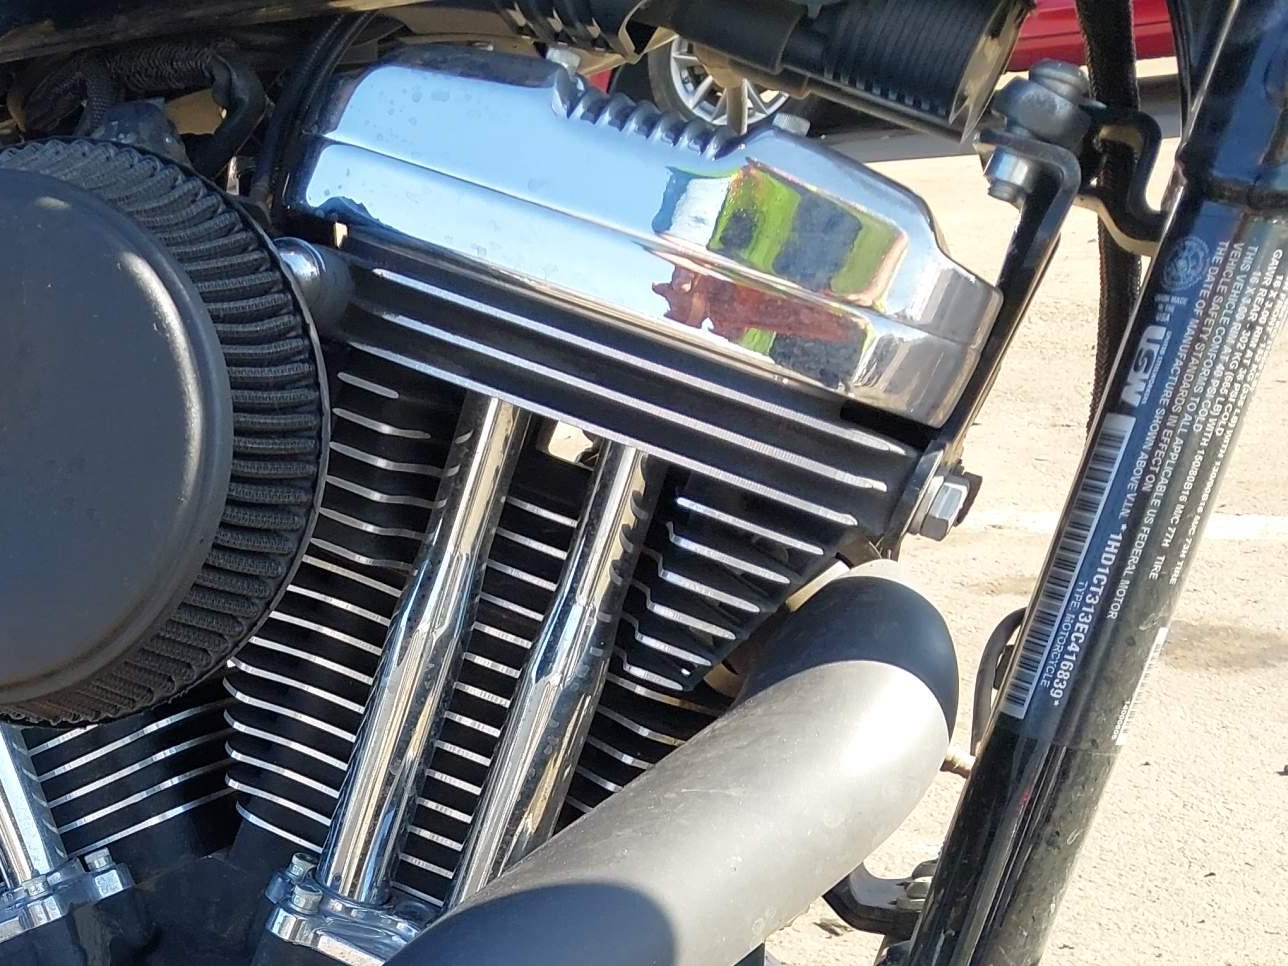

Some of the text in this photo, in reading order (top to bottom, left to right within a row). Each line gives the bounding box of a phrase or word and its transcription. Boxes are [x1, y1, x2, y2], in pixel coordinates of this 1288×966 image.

[1210, 239, 1230, 264] THE
[1260, 249, 1283, 286] GAWR
[1198, 266, 1220, 297] DATE
[1191, 299, 1208, 315] OF
[1247, 288, 1268, 321] REAR
[1225, 322, 1242, 344] RIM
[1235, 330, 1250, 348] 302
[1248, 326, 1264, 347] RIM
[1117, 321, 1167, 405] USW
[1140, 241, 1245, 491] VEHICLE SAFETY STANDARDS IN EFFECT ON
[1157, 318, 1199, 405] MANUFACTURE
[1219, 347, 1233, 361] AT
[1228, 352, 1242, 369] KG
[1241, 350, 1254, 364] AT
[1204, 379, 1220, 397] PSI
[1227, 384, 1240, 400] PSI
[1191, 399, 1212, 431] COLD
[1209, 397, 1224, 415] LB)
[1105, 244, 1259, 619] THIS VEHICLE CONFORMS TO ALL APPLICABLE US FEDERAL MOTOR
[1141, 407, 1166, 450] SHOWN
[1198, 418, 1217, 445] WITH
[1214, 406, 1232, 435] COLD
[1216, 430, 1233, 456] WITH
[1125, 452, 1150, 491] ABOVE
[1178, 449, 1205, 501] 150/80B16
[1160, 526, 1176, 547] 77H
[1147, 554, 1166, 579] TIRE
[1168, 561, 1183, 583] TIRE
[1039, 613, 1076, 687] MOTORCYCLE
